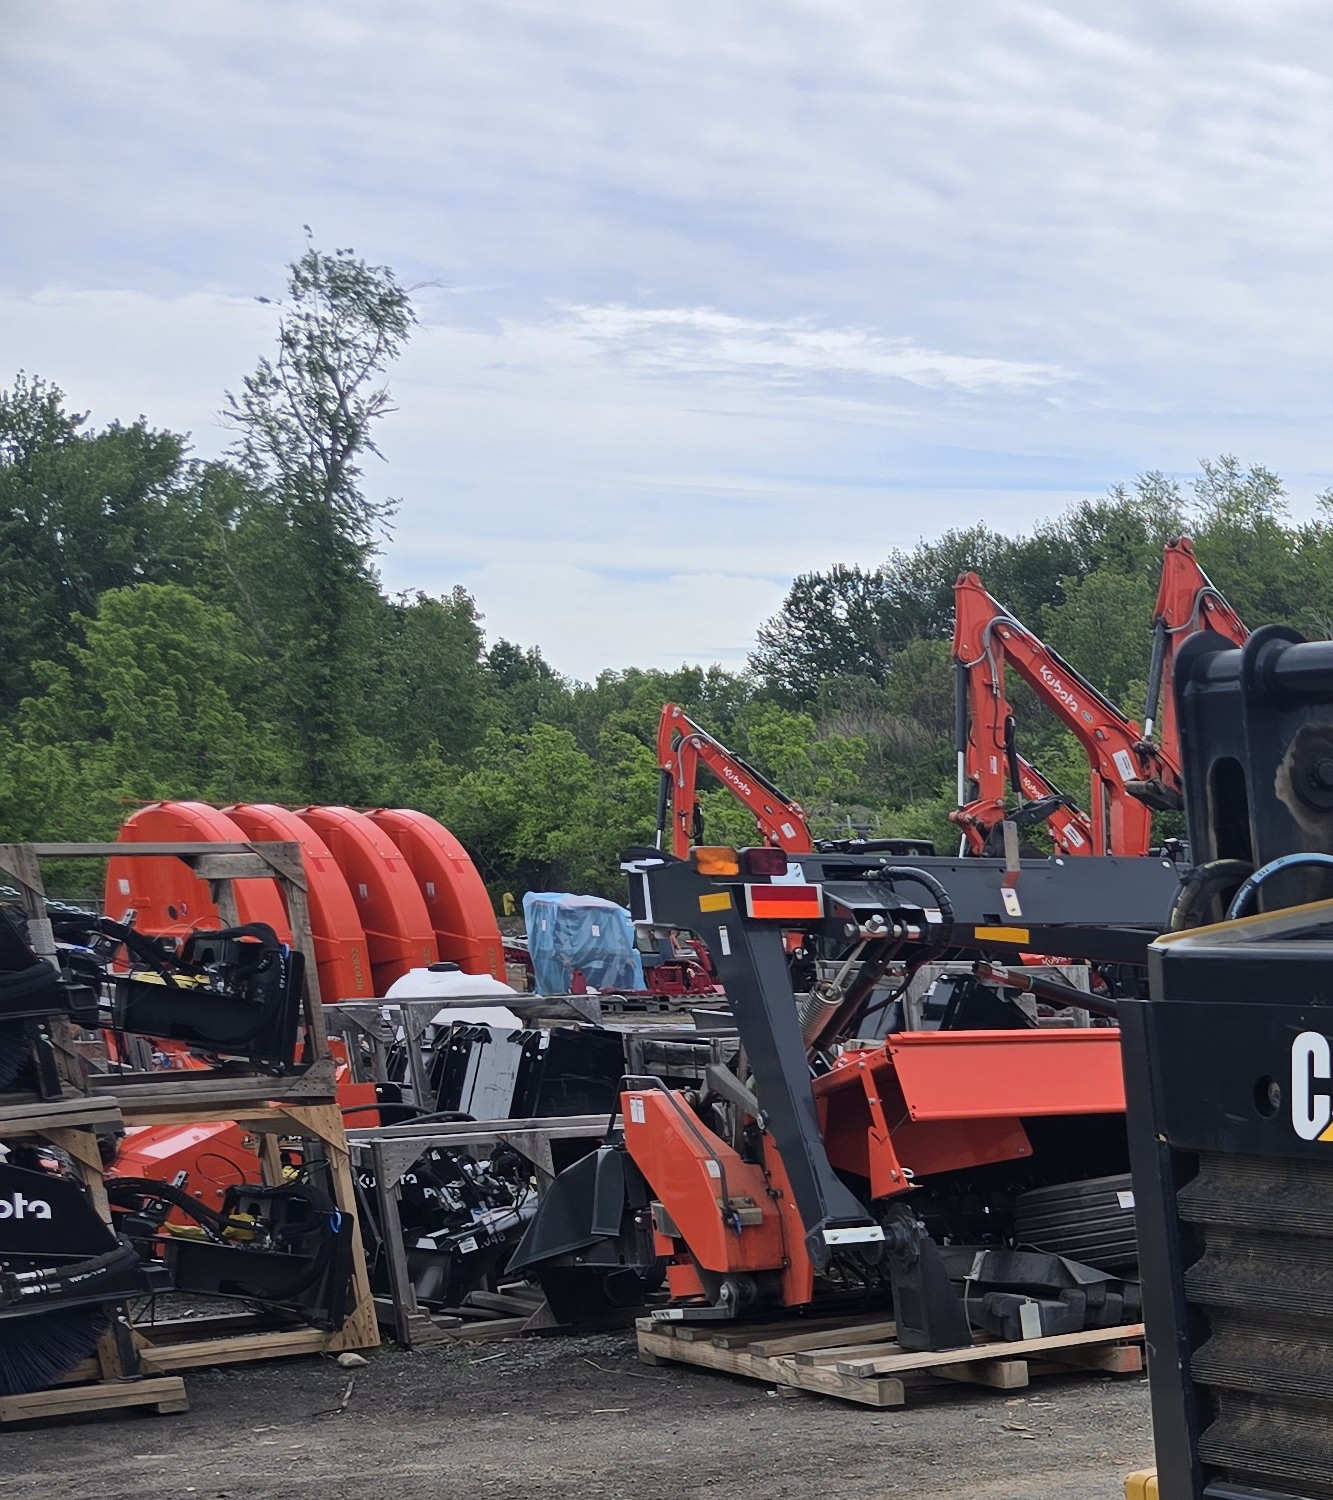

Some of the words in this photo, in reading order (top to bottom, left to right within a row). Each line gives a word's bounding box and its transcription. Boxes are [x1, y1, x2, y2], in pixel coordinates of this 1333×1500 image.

[1040, 665, 1079, 712] Kubota
[722, 765, 751, 796] Kubota
[358, 1173, 418, 1189] Kuta
